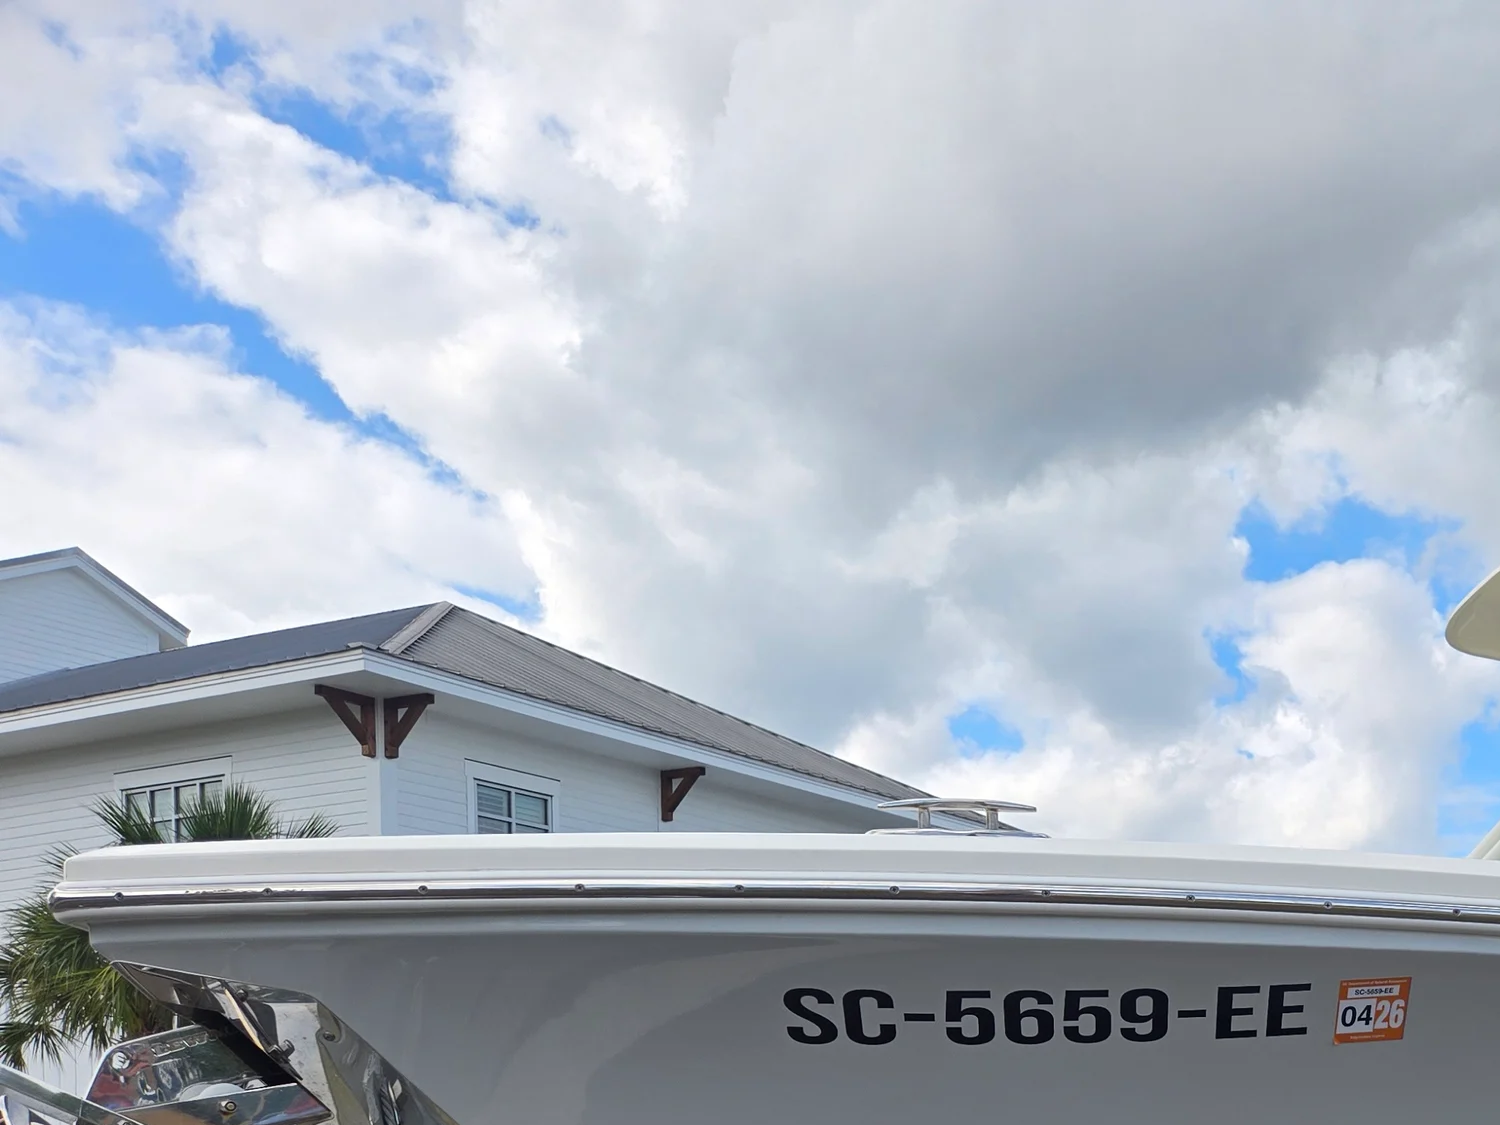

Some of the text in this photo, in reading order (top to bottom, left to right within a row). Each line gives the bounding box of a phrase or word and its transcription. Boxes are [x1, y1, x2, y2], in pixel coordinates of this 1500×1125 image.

[1354, 987, 1394, 996] SC-5659-EE
[783, 983, 1312, 1046] SC-5659-EE
[1341, 999, 1405, 1029] 04 26
